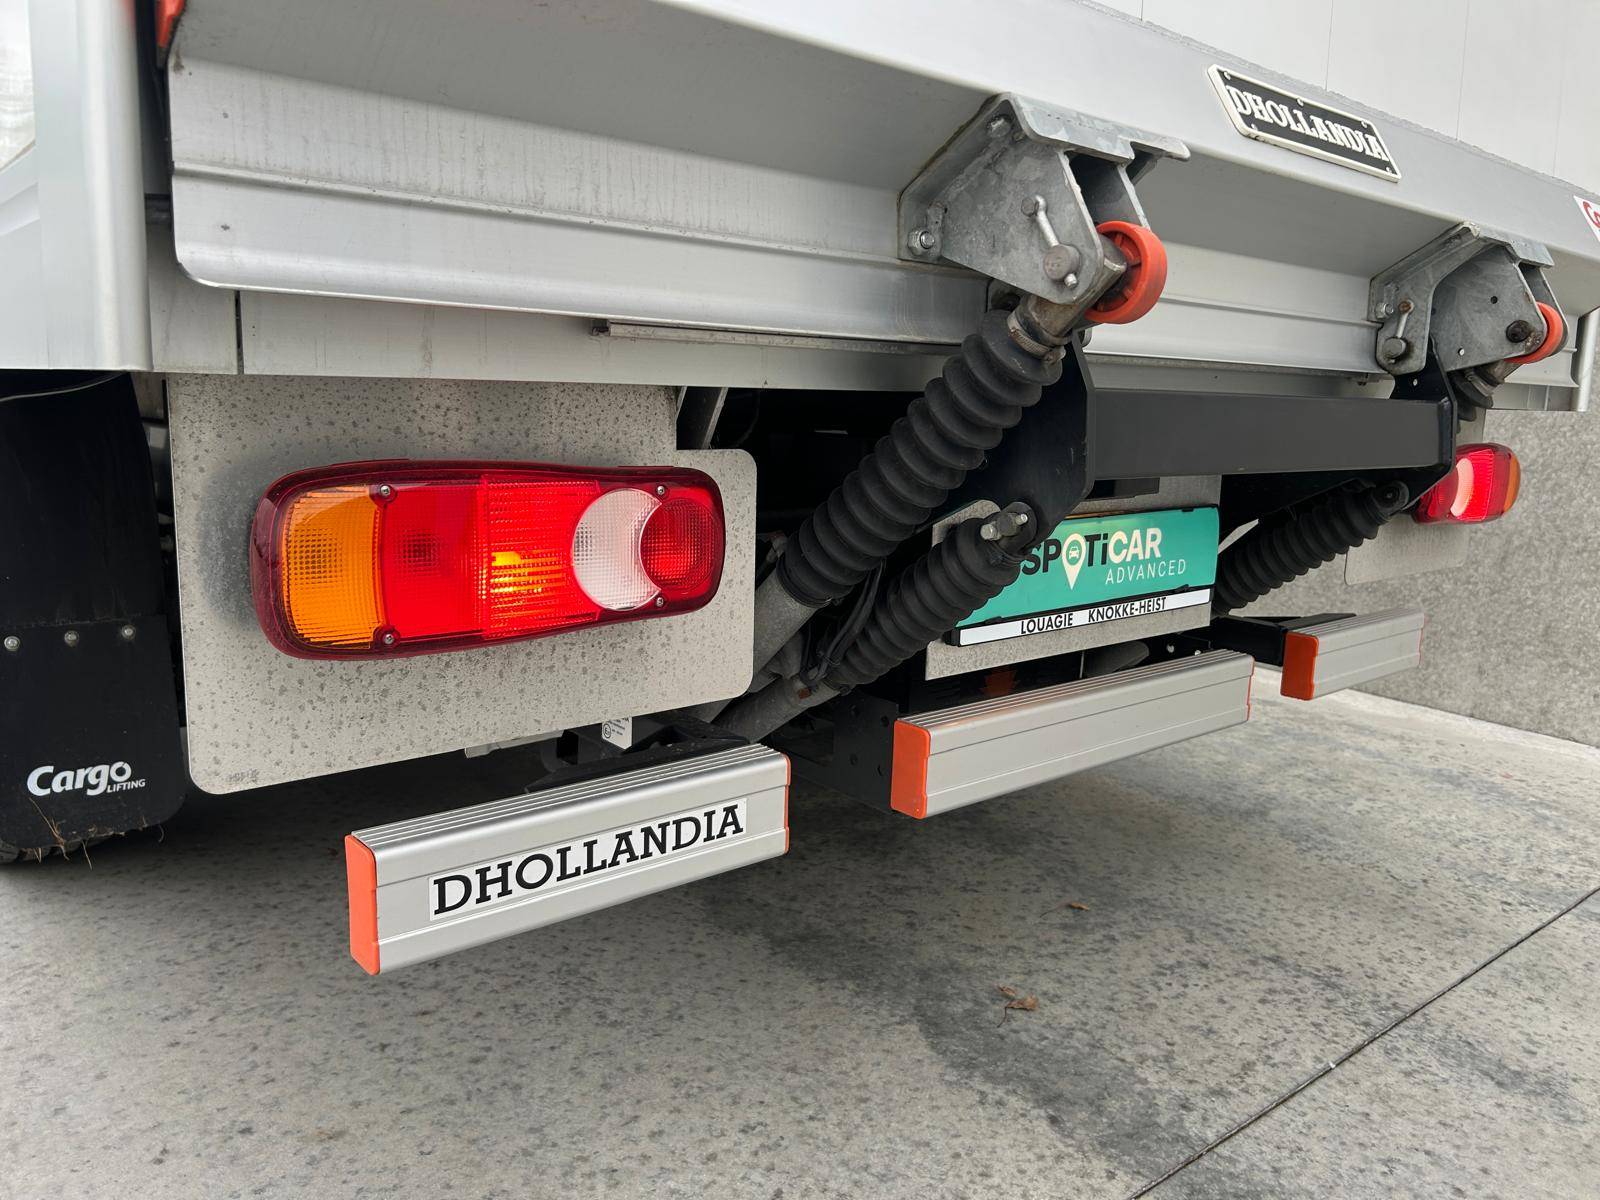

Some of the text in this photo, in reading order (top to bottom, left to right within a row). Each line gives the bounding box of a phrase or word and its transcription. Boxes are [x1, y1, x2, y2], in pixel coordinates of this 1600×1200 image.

[1225, 84, 1389, 162] DHOLLANDIA
[1105, 558, 1186, 585] ADVANCED
[1020, 596, 1167, 635] LOUAGIE KNOKKE-HEIST
[26, 761, 132, 796] Cargo
[106, 778, 146, 793] LIFTING
[433, 803, 744, 916] DHOLLANDIA
